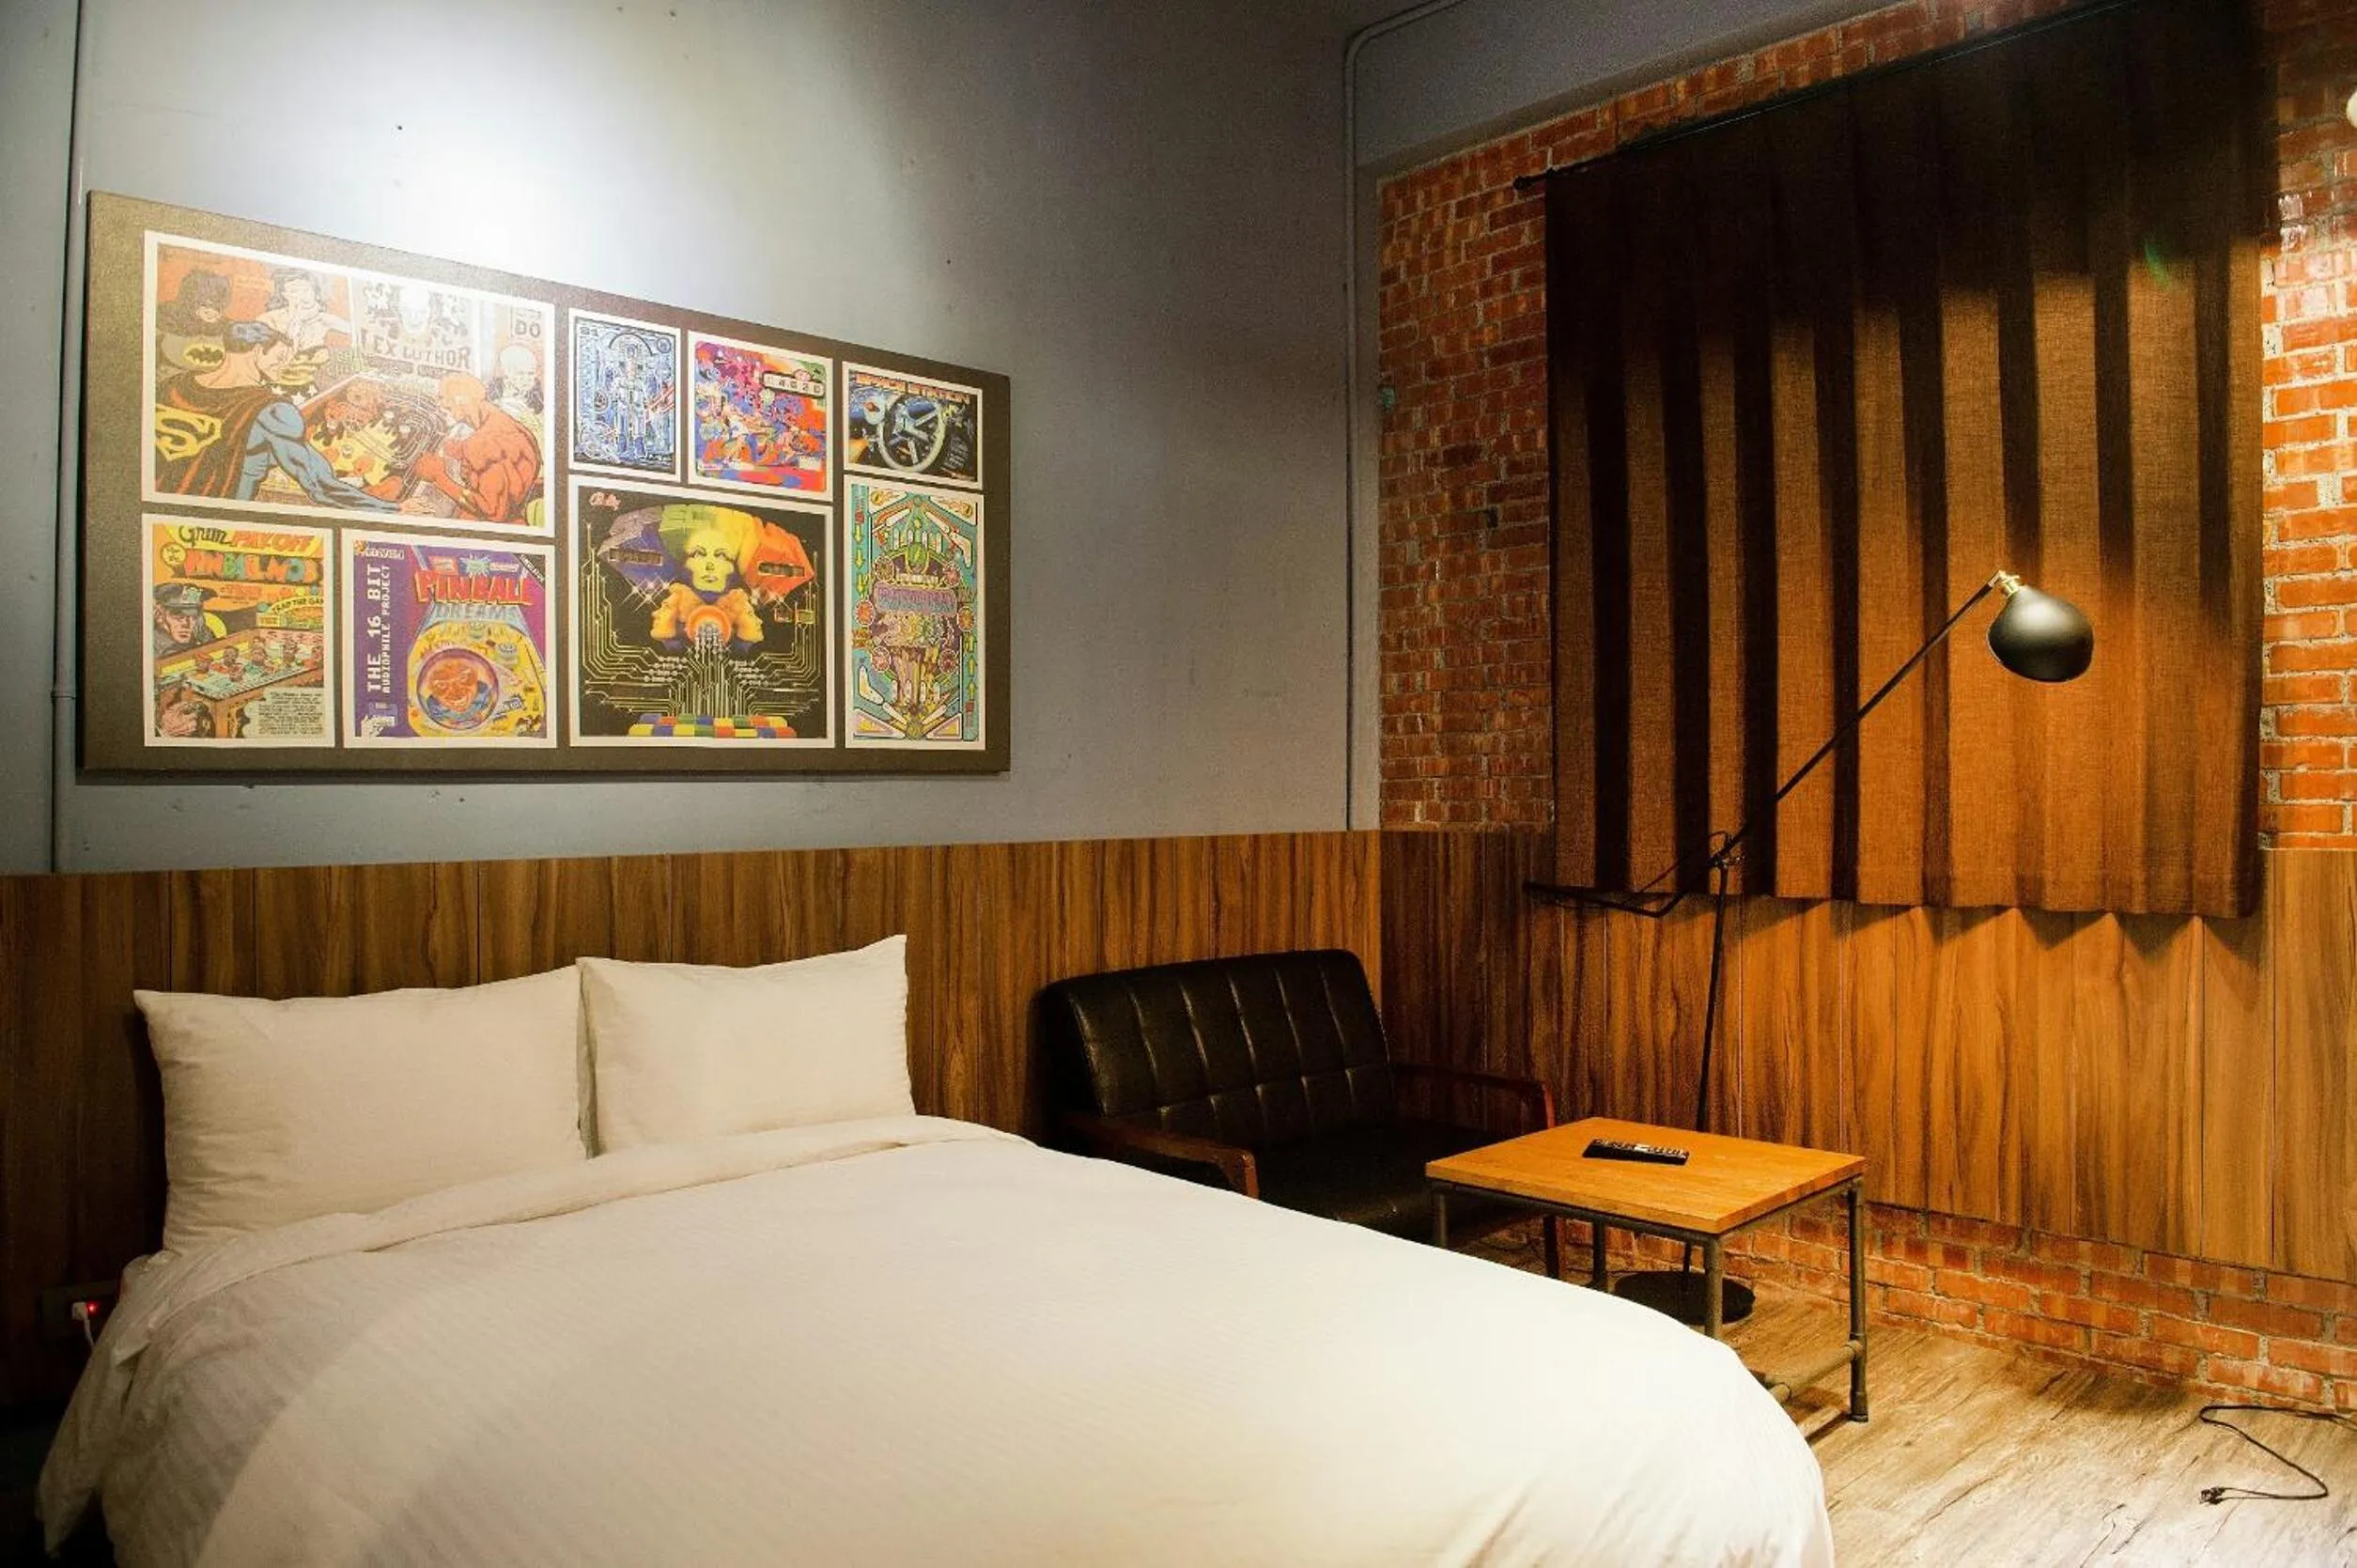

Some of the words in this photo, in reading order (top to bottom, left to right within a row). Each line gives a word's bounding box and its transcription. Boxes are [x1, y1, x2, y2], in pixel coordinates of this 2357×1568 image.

[402, 345, 472, 369] LUTHOR
[178, 525, 231, 548] Grim
[367, 564, 381, 601] BIT
[381, 566, 391, 615] PROJECT
[413, 568, 534, 606] PINBALL
[367, 615, 381, 639] 16
[367, 654, 381, 692] THE
[381, 624, 391, 693] AUDIOPHILE
